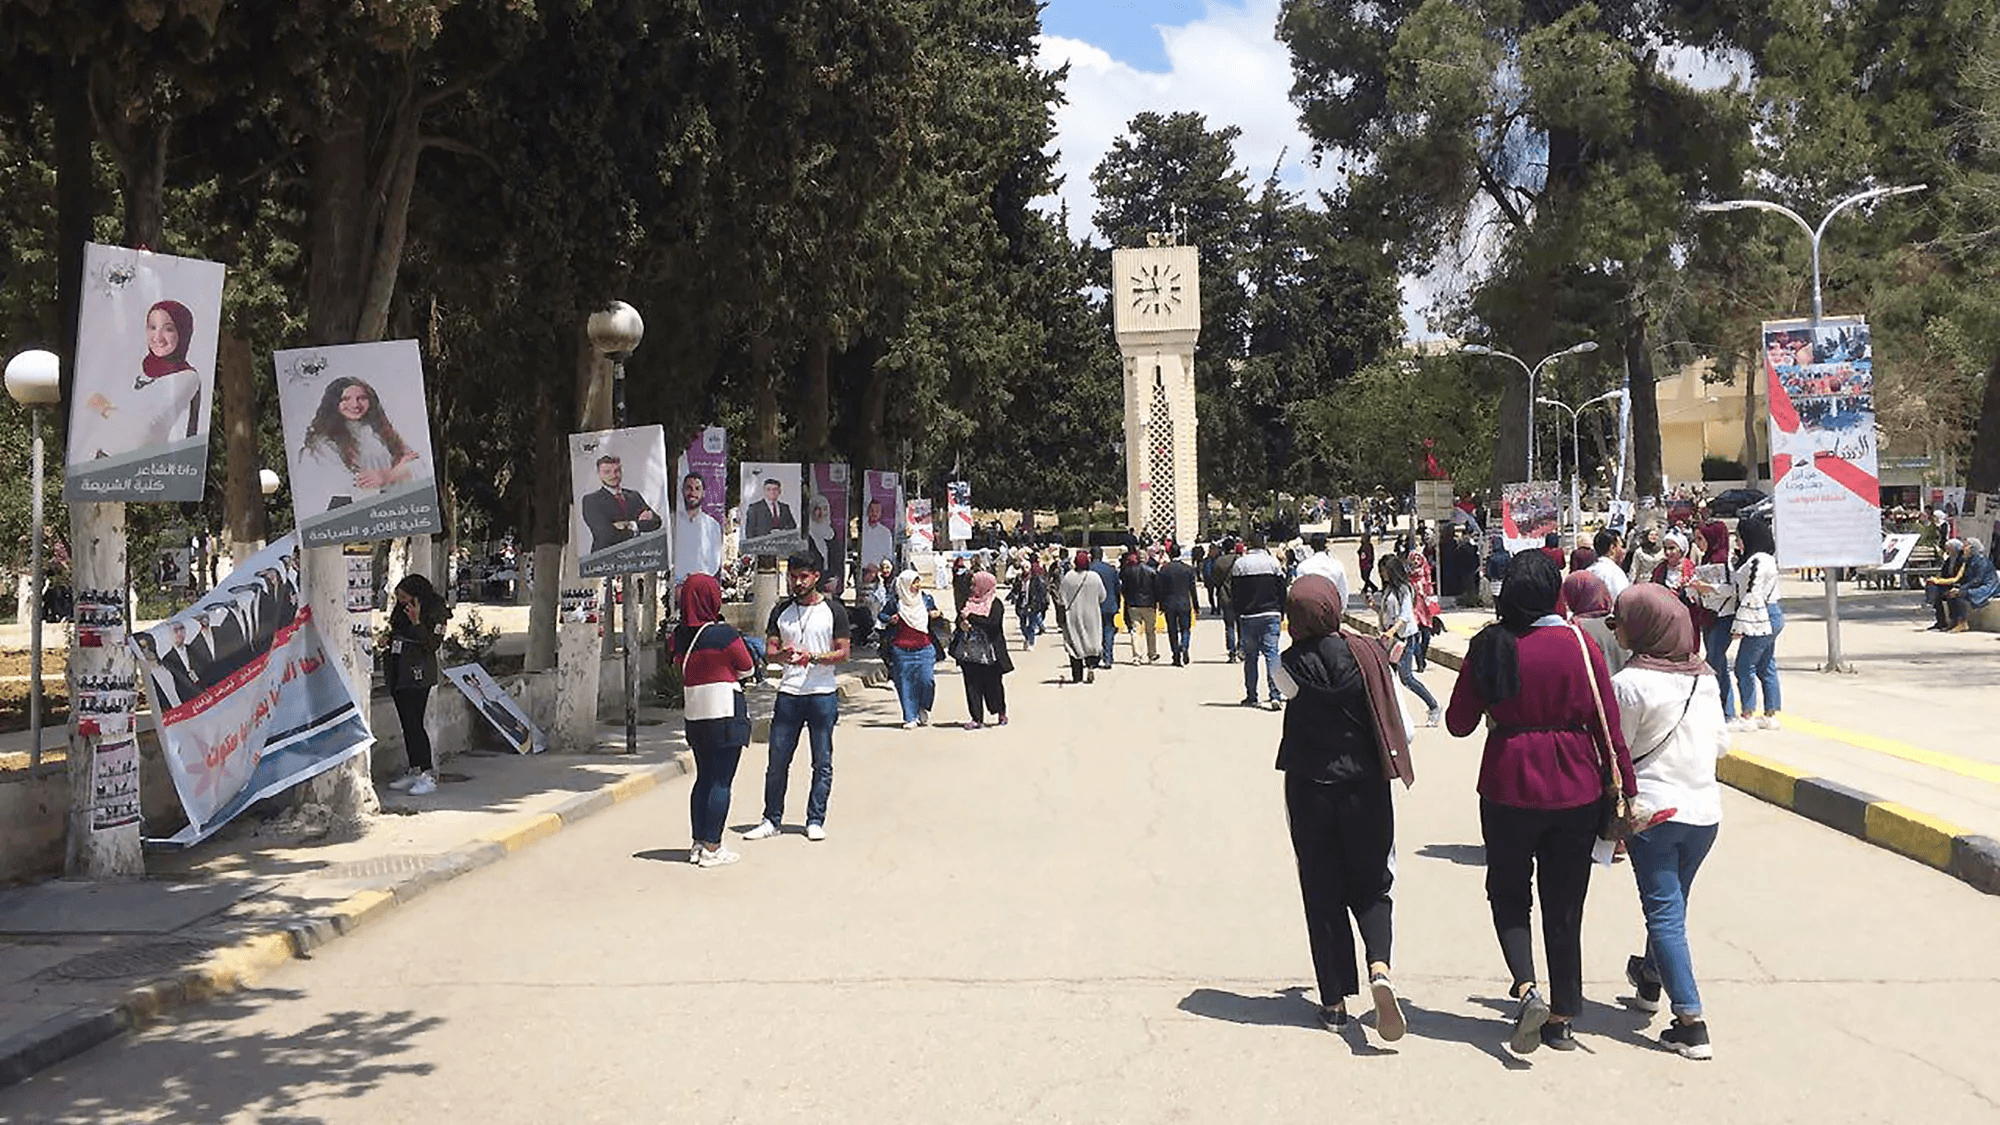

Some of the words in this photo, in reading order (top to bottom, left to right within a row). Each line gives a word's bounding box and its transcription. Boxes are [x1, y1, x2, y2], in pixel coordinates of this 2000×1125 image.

[134, 462, 175, 478] الشاعر
[80, 478, 132, 494] الشريعة
[133, 479, 165, 493] كلية
[400, 517, 432, 531] كلية
[308, 525, 359, 541] السياحة
